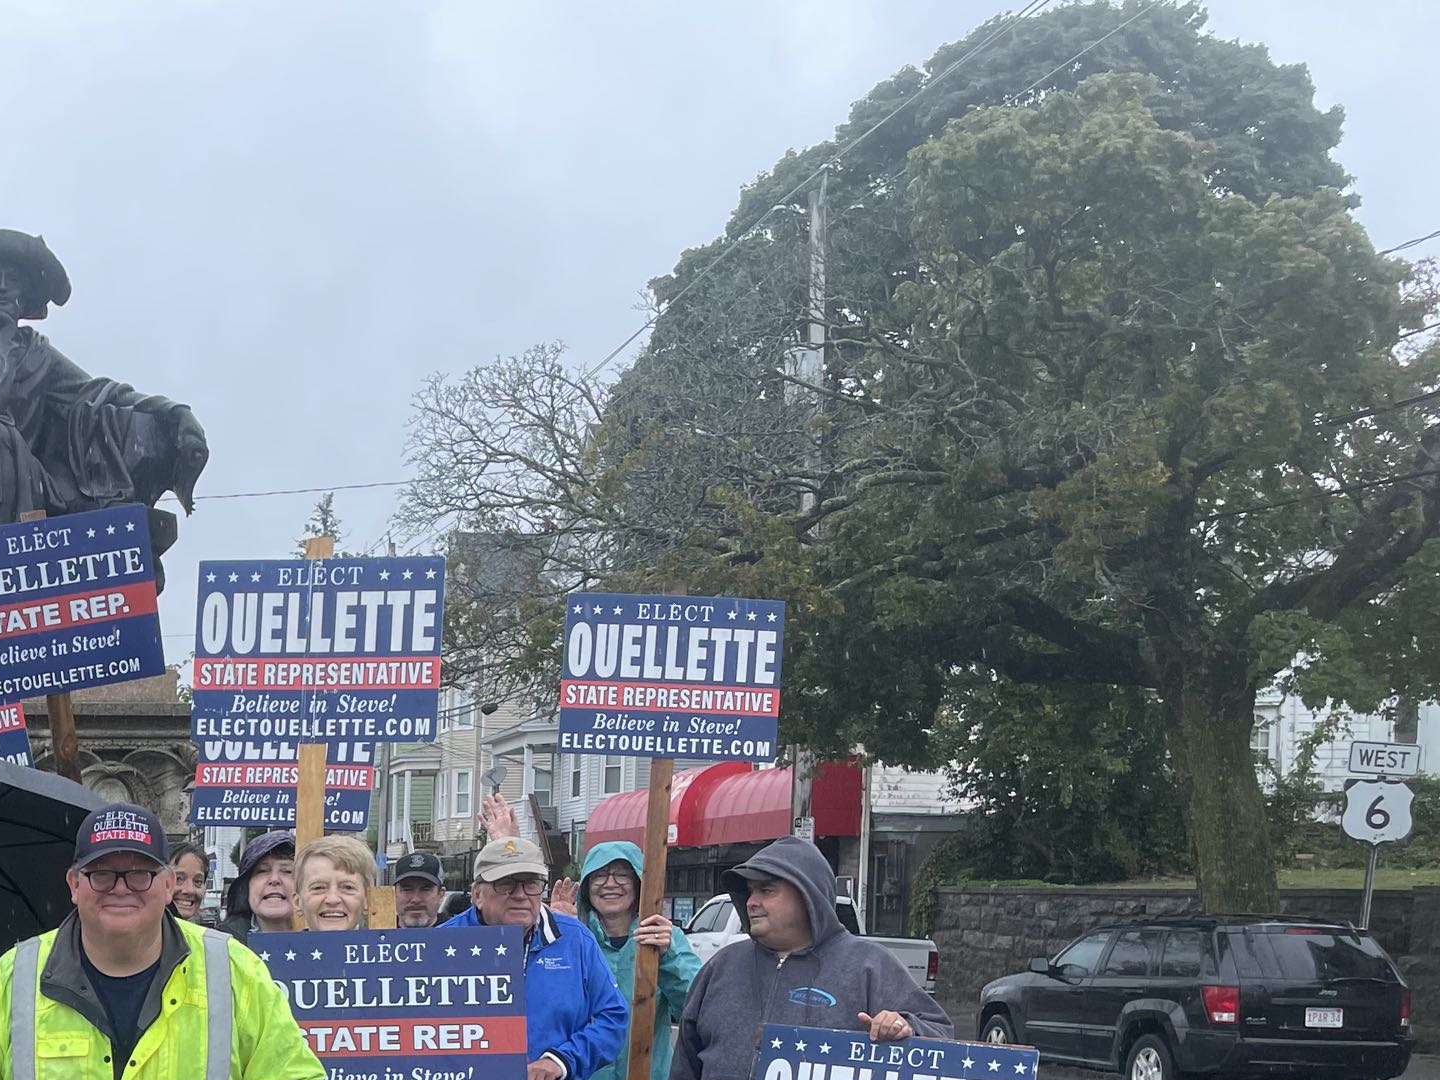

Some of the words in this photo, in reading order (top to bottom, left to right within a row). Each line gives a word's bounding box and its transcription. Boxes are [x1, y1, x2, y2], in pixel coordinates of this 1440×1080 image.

[6, 528, 72, 556] ELECT
[277, 566, 364, 587] ELECT
[69, 592, 131, 622] REP.
[636, 603, 714, 622] ELECT
[201, 590, 437, 655] OUELLETTE
[51, 638, 69, 657] in
[71, 629, 123, 654] Steve!
[568, 621, 777, 685] OUELLETTE
[200, 662, 258, 686] STATE
[263, 661, 433, 686] REPRESENTATIVE
[231, 694, 300, 713] Believe
[309, 694, 327, 713] in
[336, 694, 397, 713] Steve!
[565, 684, 618, 706] STATE
[623, 686, 773, 713] REPRESENTATIVE
[196, 718, 431, 737] ELECTOUELLETTE.COM
[592, 713, 655, 731] Believe
[663, 716, 680, 733] in
[687, 717, 742, 735] Steve!
[561, 733, 770, 757] ELECTOUELLETTE.COM
[1359, 749, 1411, 769] WEST
[202, 767, 242, 783] STATE
[245, 767, 368, 787] REPRESATIVE
[221, 790, 270, 804] Believe
[275, 790, 290, 804] in
[105, 811, 137, 822] ELECT
[197, 807, 364, 825] ELECTOUELLE.COM
[1365, 795, 1391, 830] 6
[93, 820, 149, 833] OUELLETTE
[95, 830, 126, 842] STATE
[127, 831, 147, 842] REP
[344, 943, 426, 964] ELECT
[412, 1024, 489, 1050] REP.
[848, 1041, 945, 1070] ELECT
